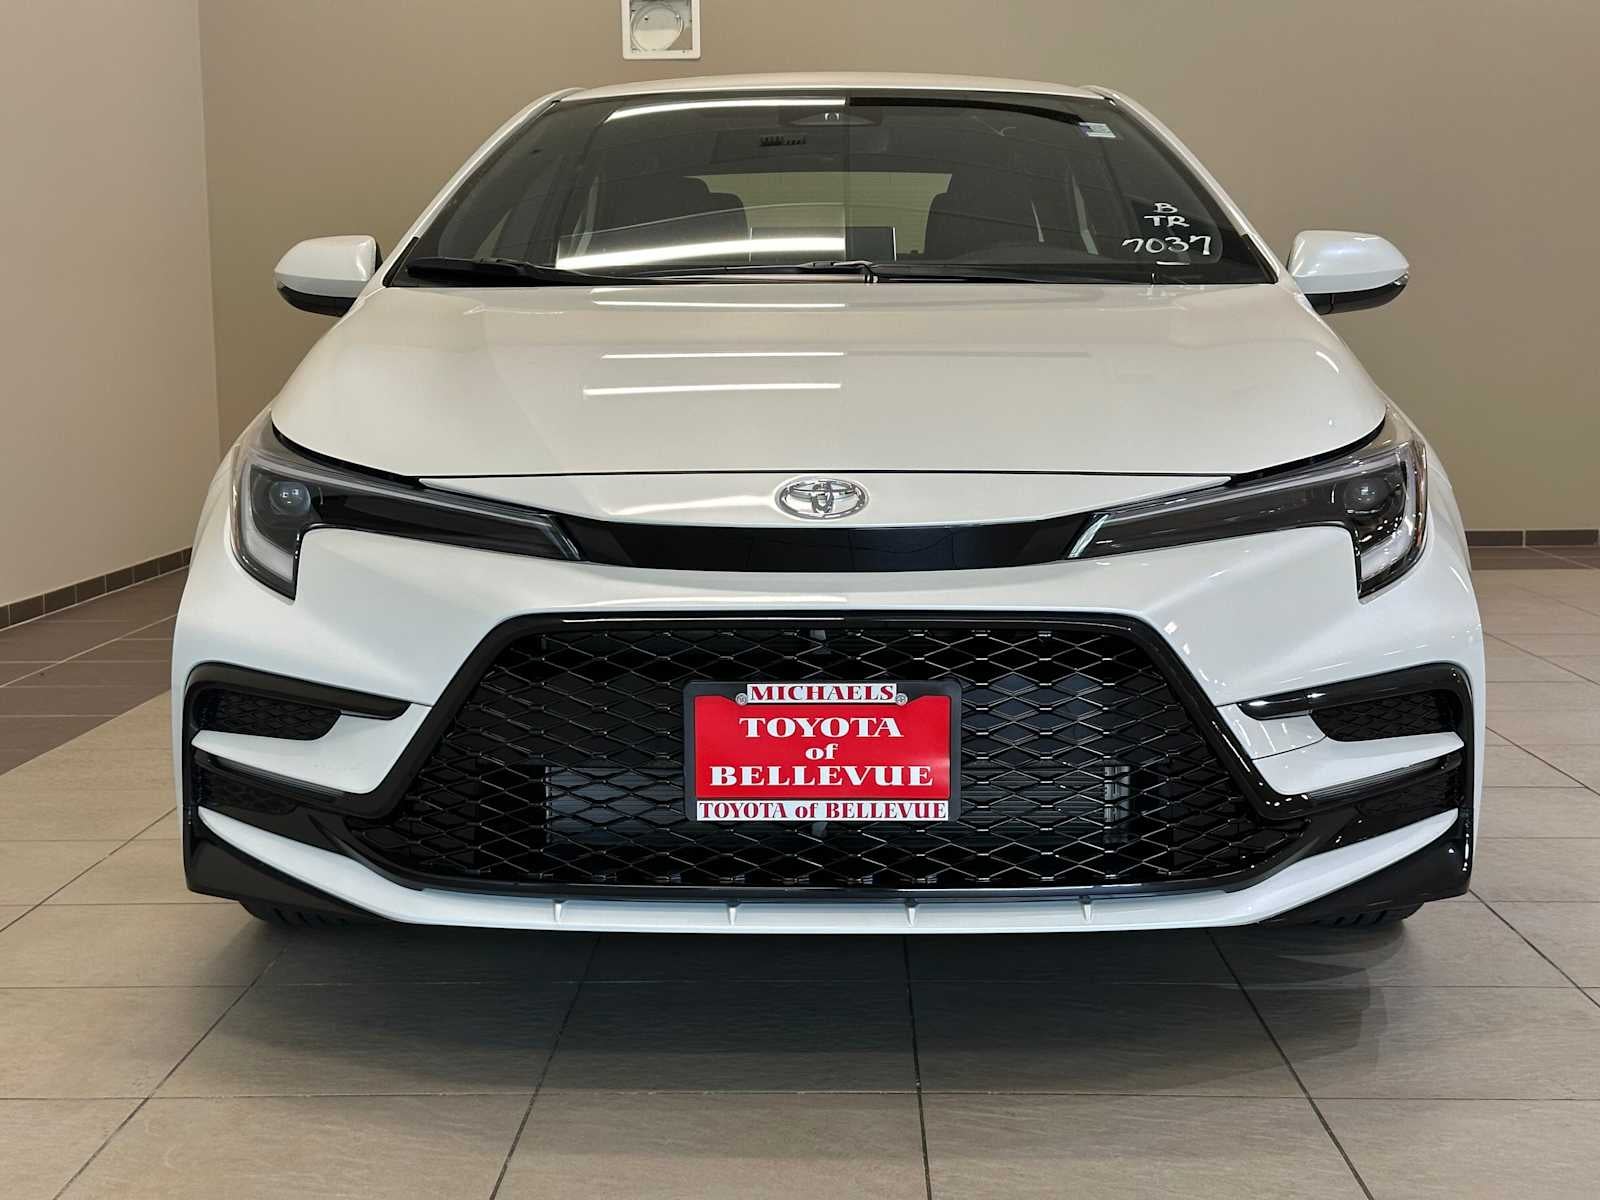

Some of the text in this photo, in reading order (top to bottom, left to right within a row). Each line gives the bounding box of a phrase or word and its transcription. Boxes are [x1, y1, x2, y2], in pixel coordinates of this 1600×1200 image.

[1153, 203, 1178, 214] B
[1144, 215, 1190, 227] TR
[1122, 235, 1211, 255] 7037
[750, 685, 894, 701] MICHAELS
[739, 717, 905, 738] TOYOTA
[804, 743, 839, 760] of
[709, 765, 933, 786] BELLEVUE
[699, 802, 946, 818] TOYOTA of BELLEVUE
